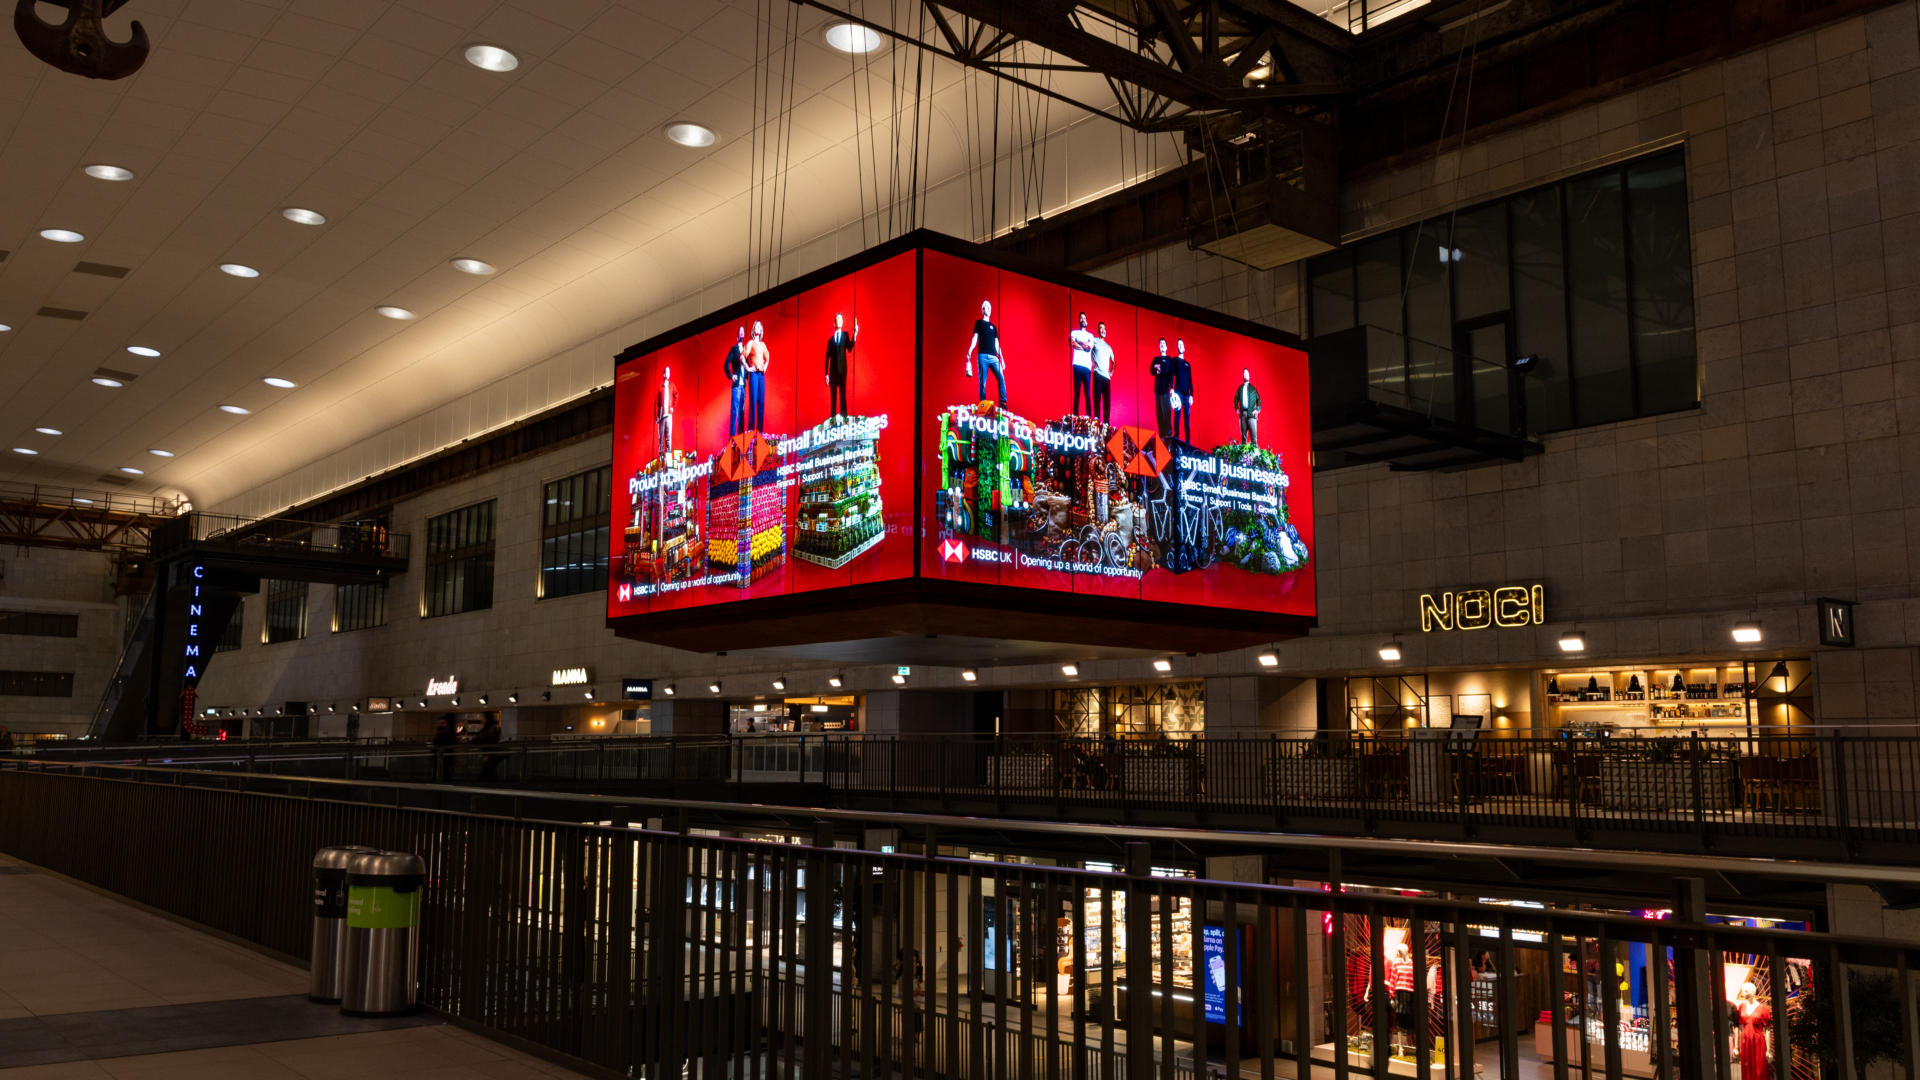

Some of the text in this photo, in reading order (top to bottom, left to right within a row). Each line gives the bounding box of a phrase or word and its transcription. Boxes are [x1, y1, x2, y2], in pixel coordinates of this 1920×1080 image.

[777, 413, 888, 456] small businesses
[957, 408, 1097, 452] Proud to support
[629, 460, 713, 495] Proud to support
[776, 463, 795, 477] HSBC
[796, 457, 813, 472] Small
[814, 453, 844, 467] Business
[802, 470, 824, 483] Support
[829, 467, 845, 476] Tools
[1180, 456, 1290, 487] small businesses
[1181, 480, 1202, 491] HSBC
[1202, 484, 1221, 495] Small
[1222, 487, 1251, 500] Business
[1181, 493, 1278, 516] Finance Support Tools Growth
[971, 548, 1143, 580] HSBC UK Opening up a world of opportunity
[633, 585, 649, 596] HSBC
[649, 584, 657, 594] UK
[660, 581, 680, 593] Opening
[680, 580, 688, 590] up
[692, 575, 707, 587] world
[707, 575, 713, 585] of
[713, 570, 742, 584] opportunity
[185, 566, 204, 677] CINEMA
[1420, 584, 1544, 632] NOCI
[1830, 608, 1845, 638] N
[552, 667, 588, 686] MANNA
[1203, 935, 1215, 944] larna
[1203, 944, 1214, 952] pple
